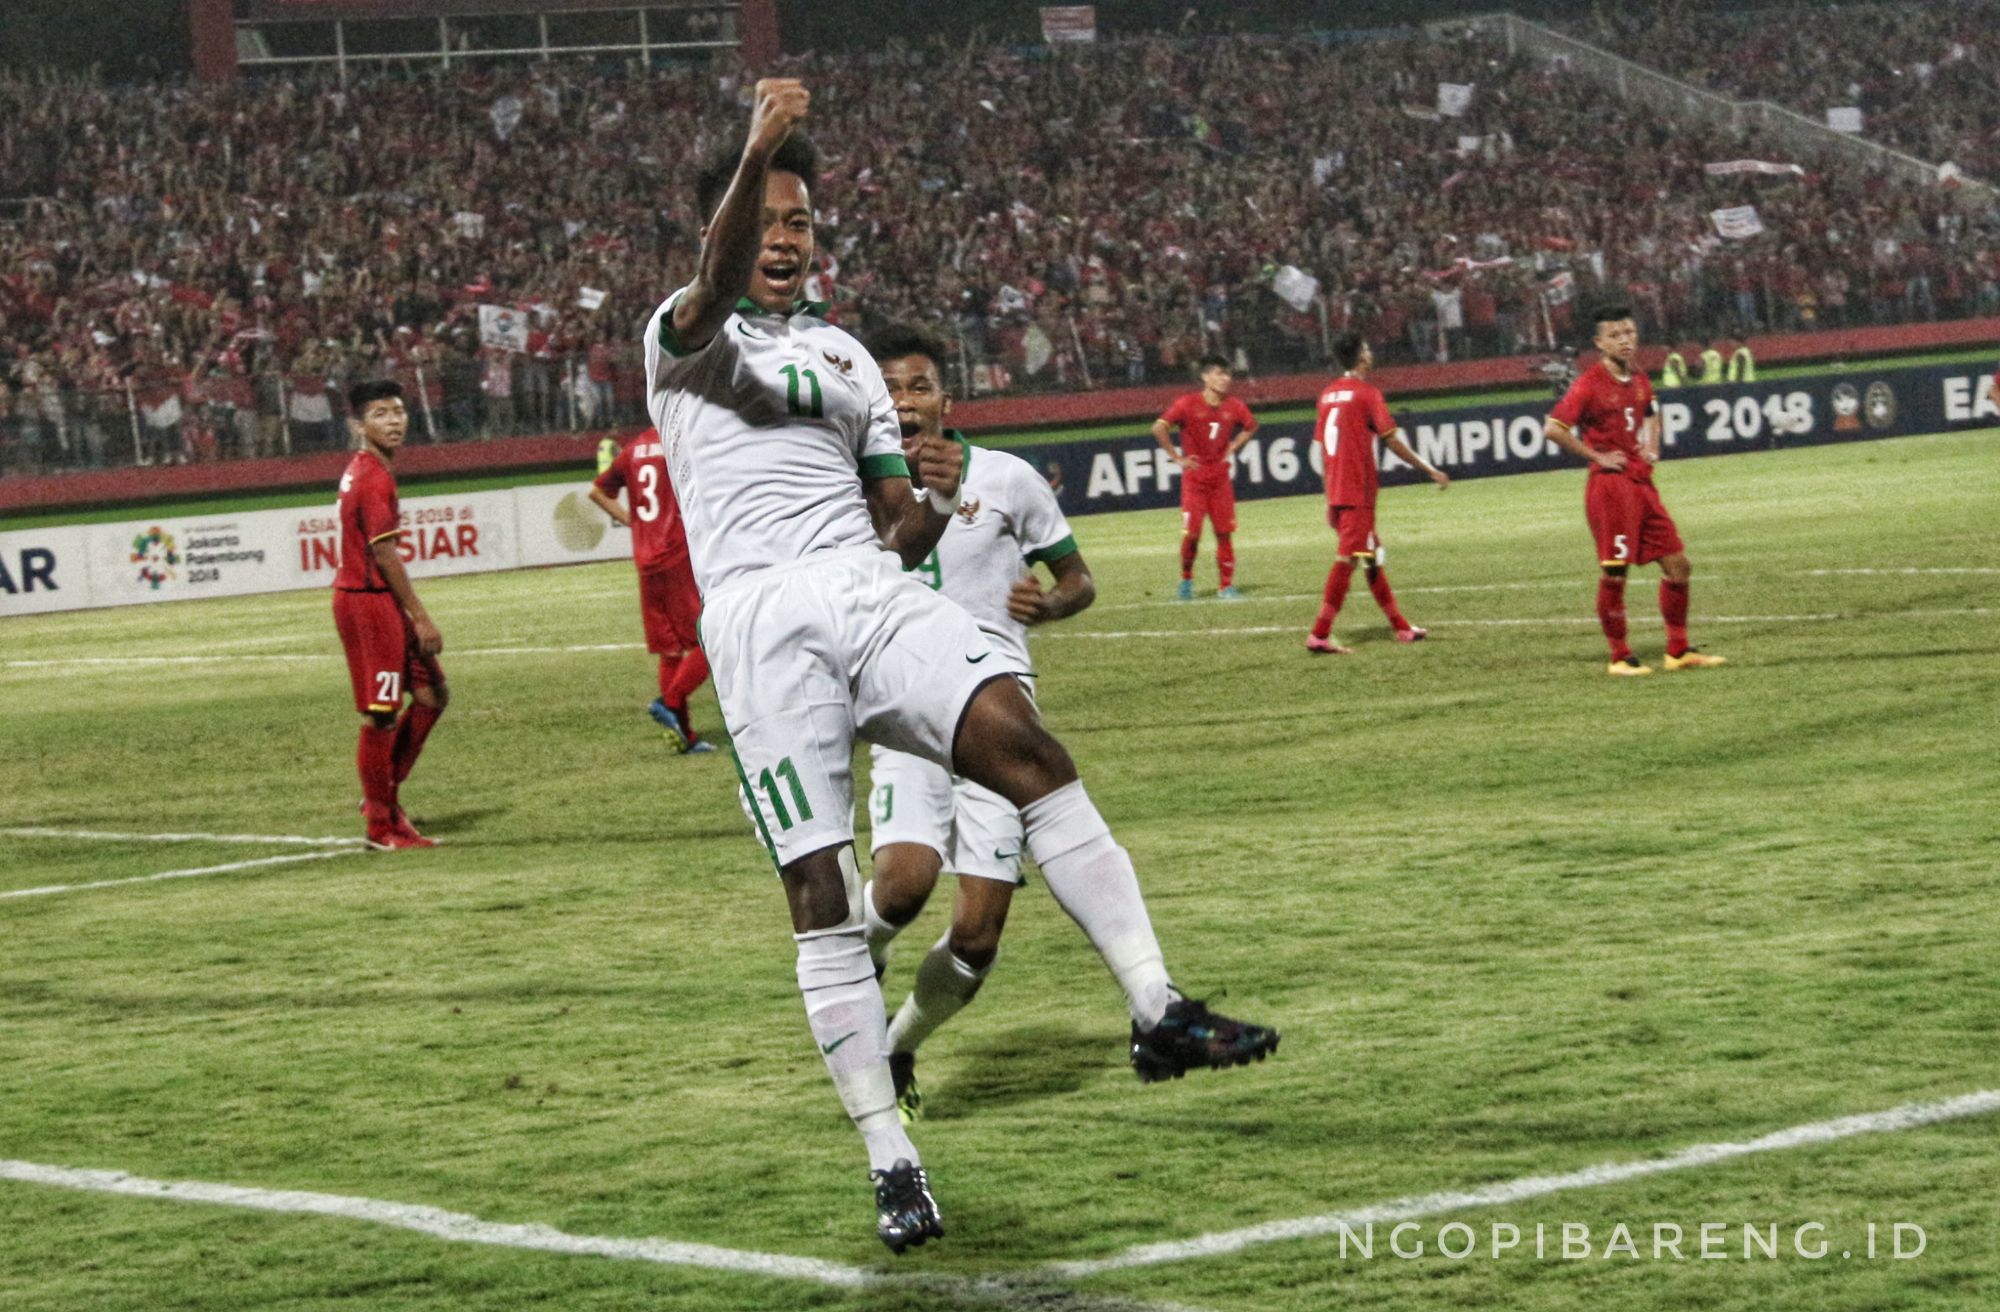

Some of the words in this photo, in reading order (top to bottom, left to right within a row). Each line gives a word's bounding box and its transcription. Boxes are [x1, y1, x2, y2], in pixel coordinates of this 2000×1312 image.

[778, 363, 824, 418] 11
[1208, 422, 1220, 440] 7
[1324, 407, 1339, 457] 6
[1624, 407, 1635, 432] 5
[1087, 448, 1184, 498] AFF
[1703, 391, 1814, 440] 2018
[636, 464, 660, 522] 3
[298, 517, 338, 534] ASIA
[415, 507, 454, 526] 2018
[185, 536, 240, 550] Jakarta
[186, 549, 265, 565] Palembang
[299, 524, 479, 572] INSIAR
[1614, 534, 1629, 559] 5
[188, 567, 220, 584] 2018
[376, 671, 400, 702] 21
[759, 756, 815, 832] 11
[875, 782, 894, 824] 9
